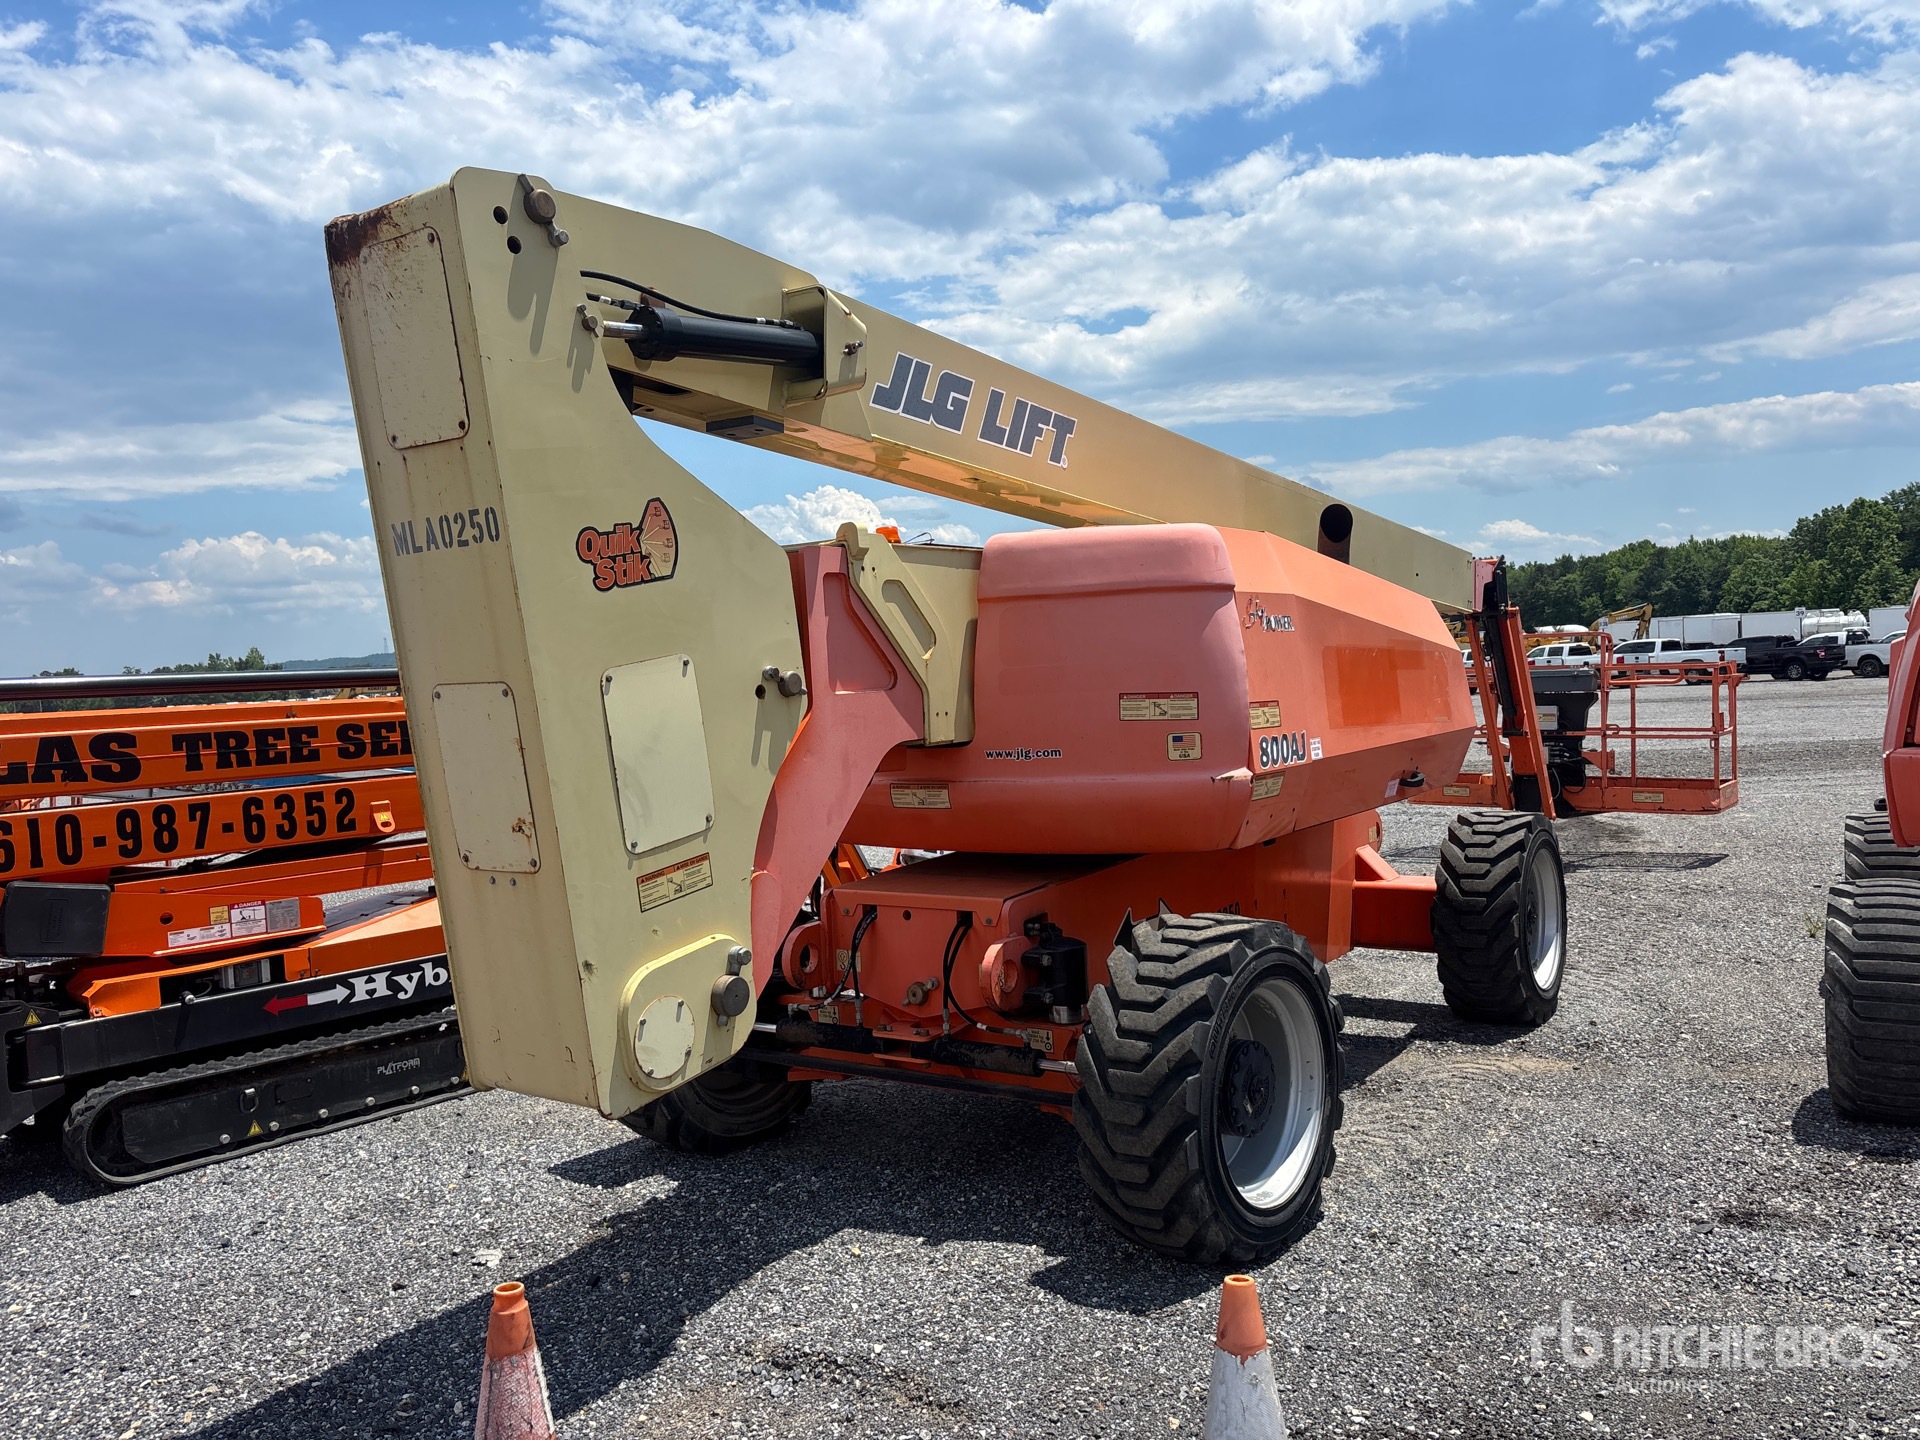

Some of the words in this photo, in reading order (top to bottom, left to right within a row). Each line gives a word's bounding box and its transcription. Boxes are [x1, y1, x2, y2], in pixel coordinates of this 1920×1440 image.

[869, 351, 975, 435] JLG
[977, 387, 1078, 468] LIFT
[391, 506, 500, 557] MLA0250
[579, 524, 641, 564] Quik
[595, 552, 651, 589] Stik
[172, 725, 321, 772] TREE
[984, 747, 1062, 761] www.jlg.com
[1259, 730, 1307, 770] 800AJ
[0, 787, 357, 873] 610-987-6352
[238, 900, 262, 908] DANGER
[347, 961, 452, 1004] Hyb
[376, 1057, 421, 1076] PLATFORM
